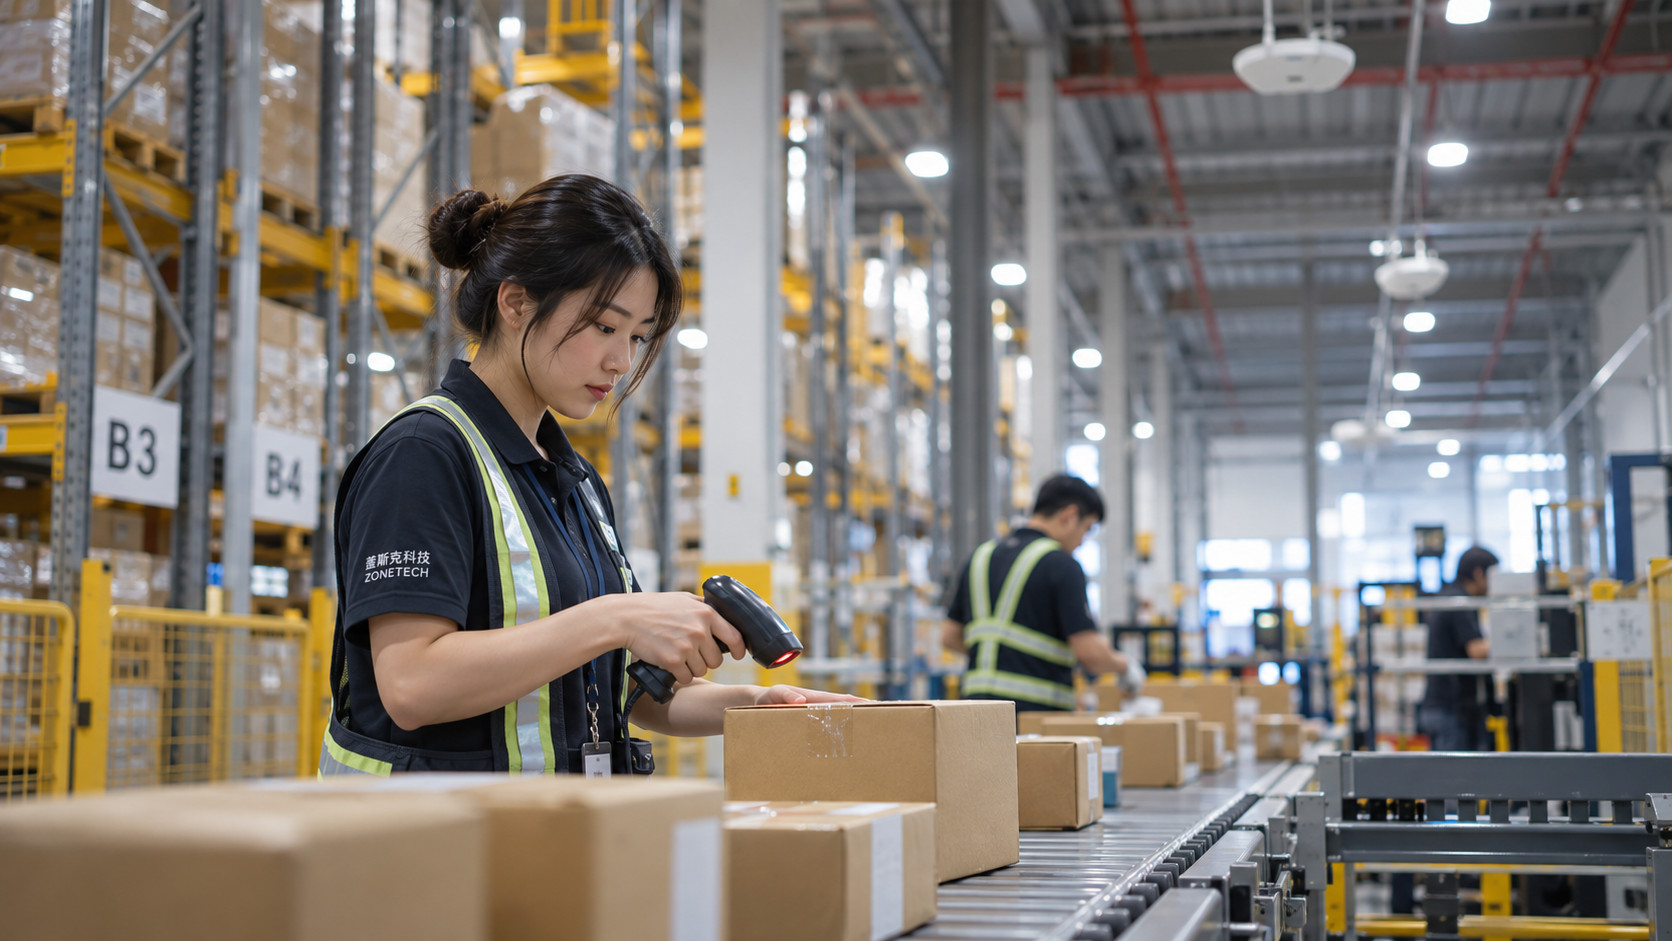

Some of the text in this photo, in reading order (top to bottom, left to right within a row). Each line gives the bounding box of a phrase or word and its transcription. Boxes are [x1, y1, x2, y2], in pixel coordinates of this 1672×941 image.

[107, 420, 157, 476] B3
[266, 452, 302, 499] B4
[364, 567, 429, 583] ZONETECH
